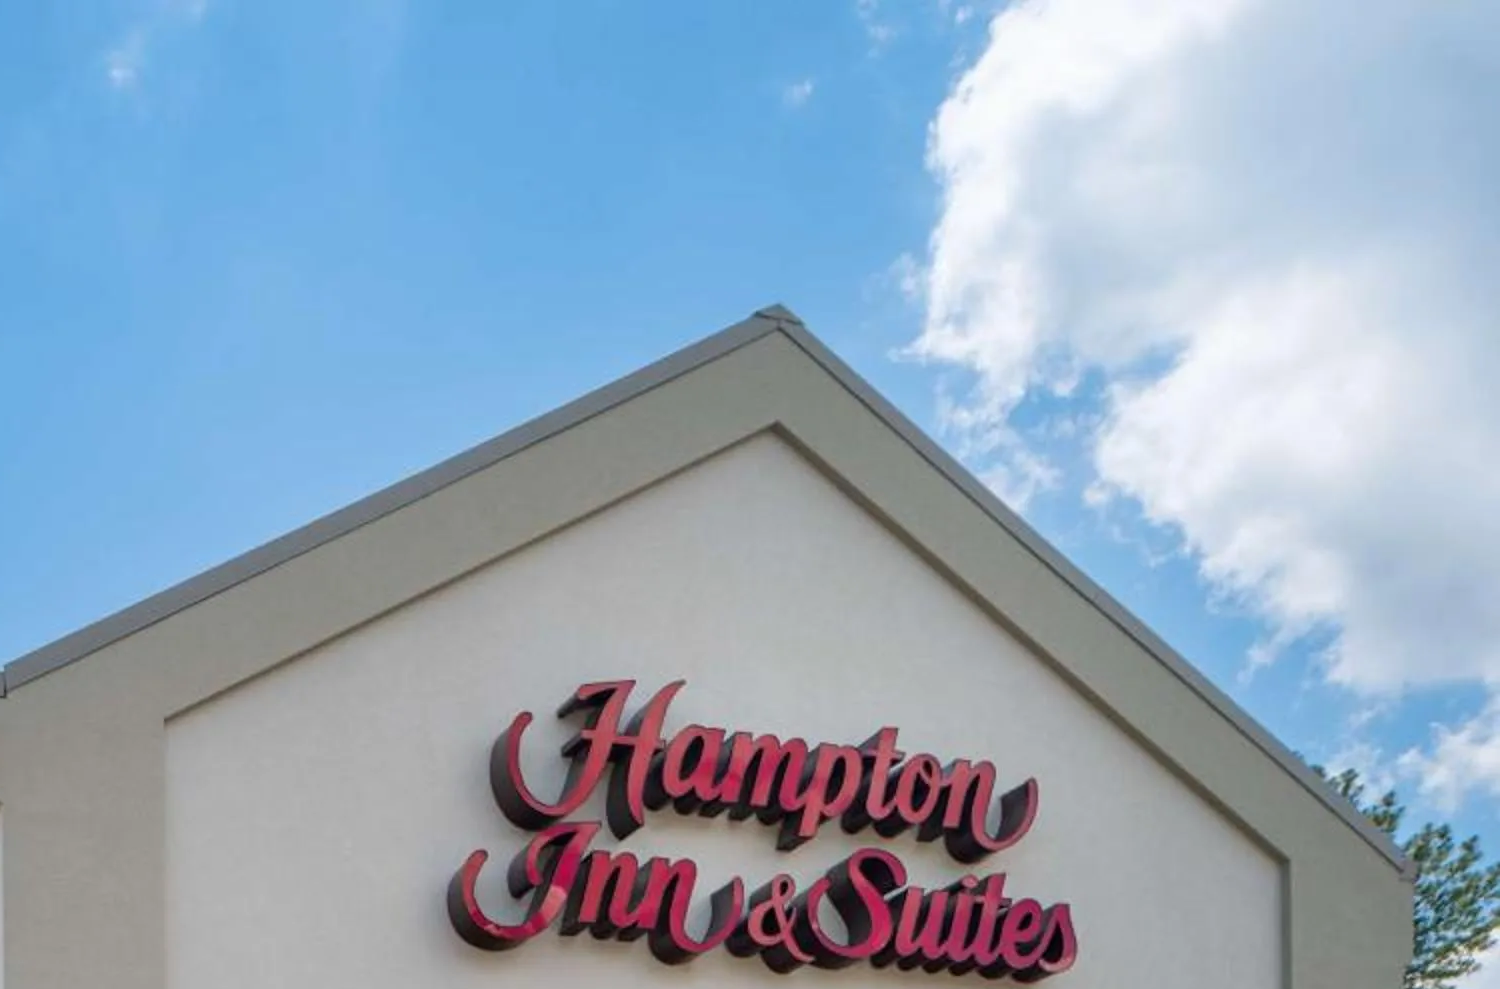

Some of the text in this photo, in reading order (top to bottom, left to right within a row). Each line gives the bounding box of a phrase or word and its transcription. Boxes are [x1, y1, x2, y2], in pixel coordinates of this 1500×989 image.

[490, 680, 1038, 863] Hampton
[448, 821, 1078, 983] Inn & Suites
